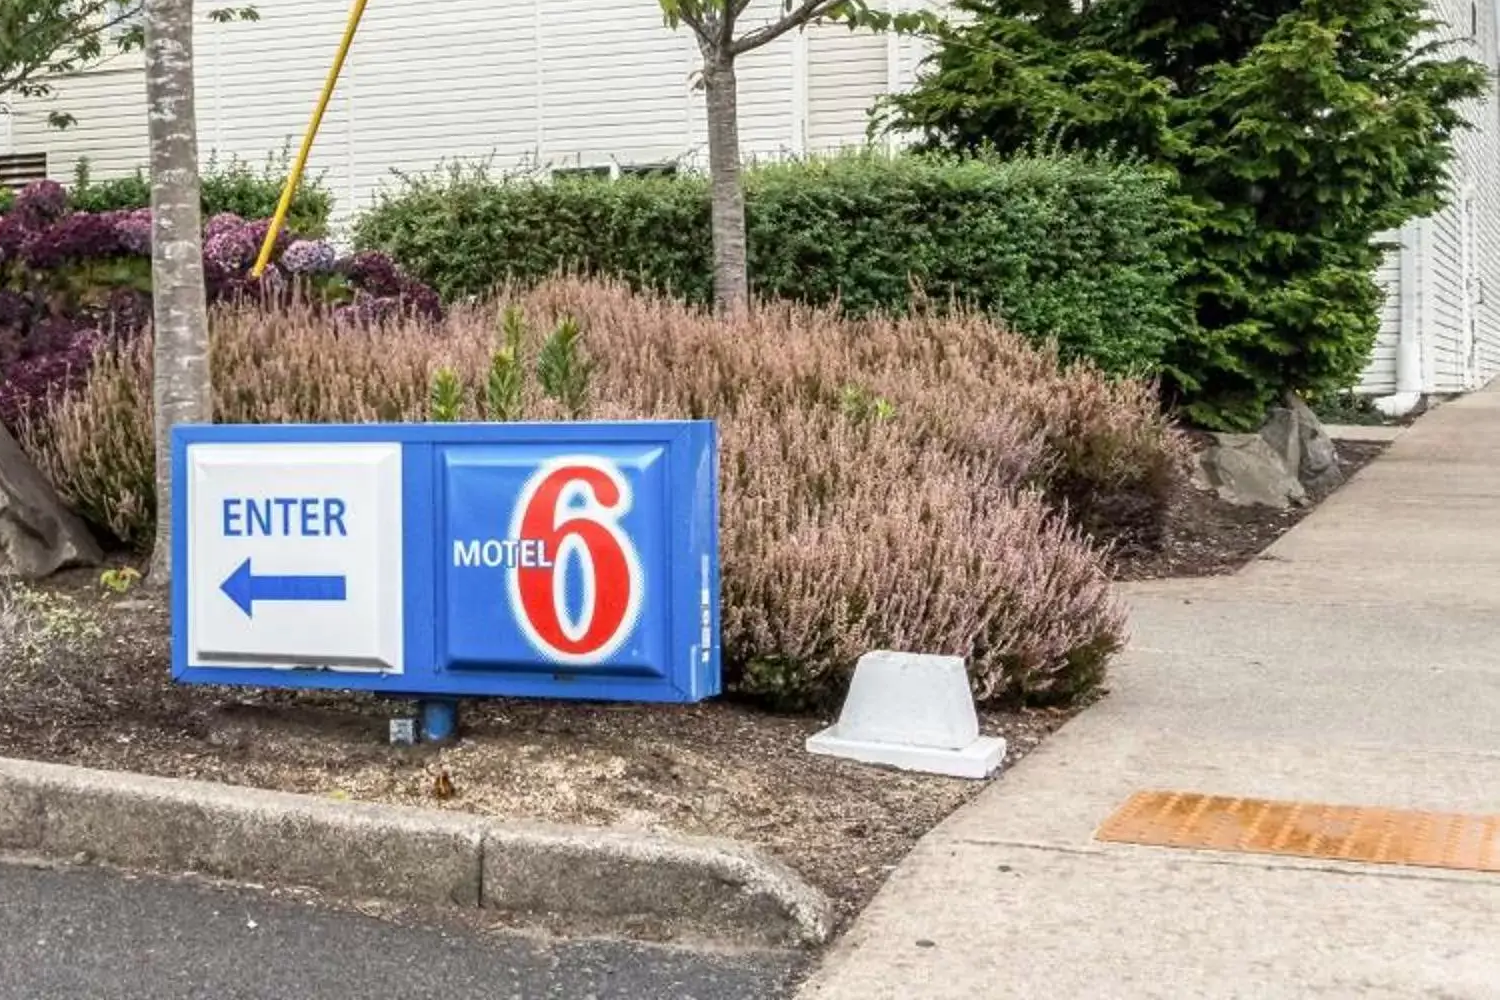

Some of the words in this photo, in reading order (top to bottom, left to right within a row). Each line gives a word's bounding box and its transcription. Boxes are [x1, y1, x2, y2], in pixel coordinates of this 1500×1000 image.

[222, 498, 347, 537] ENTER
[453, 538, 552, 568] MOTEL
[514, 462, 634, 658] 6
